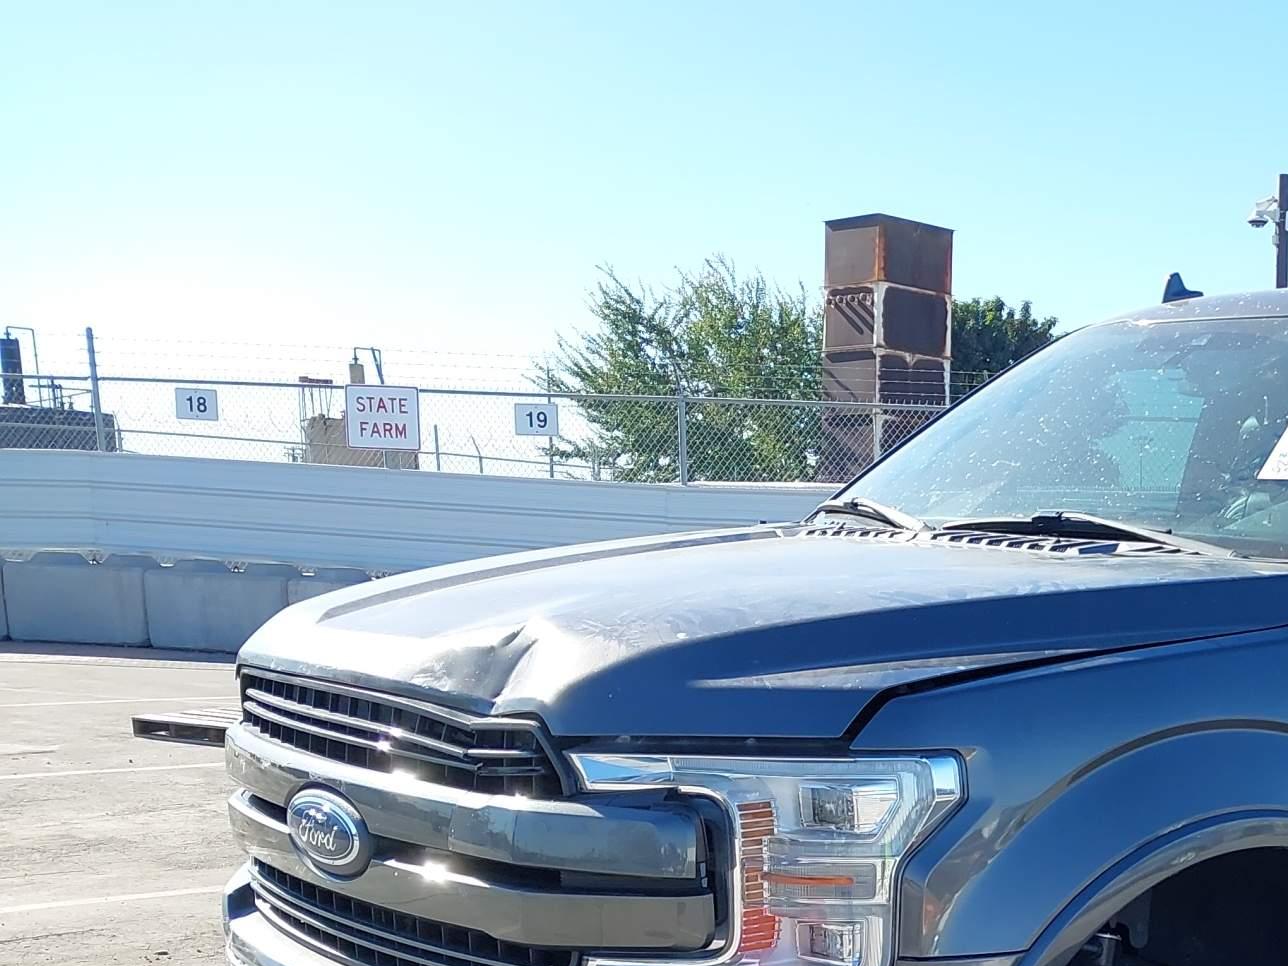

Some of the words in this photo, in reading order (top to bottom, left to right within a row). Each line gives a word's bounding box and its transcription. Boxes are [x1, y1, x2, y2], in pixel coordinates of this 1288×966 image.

[185, 395, 208, 414] 18
[355, 395, 409, 415] STATE
[525, 411, 548, 429] 19
[359, 421, 408, 440] FARM
[298, 808, 340, 852] Ford
